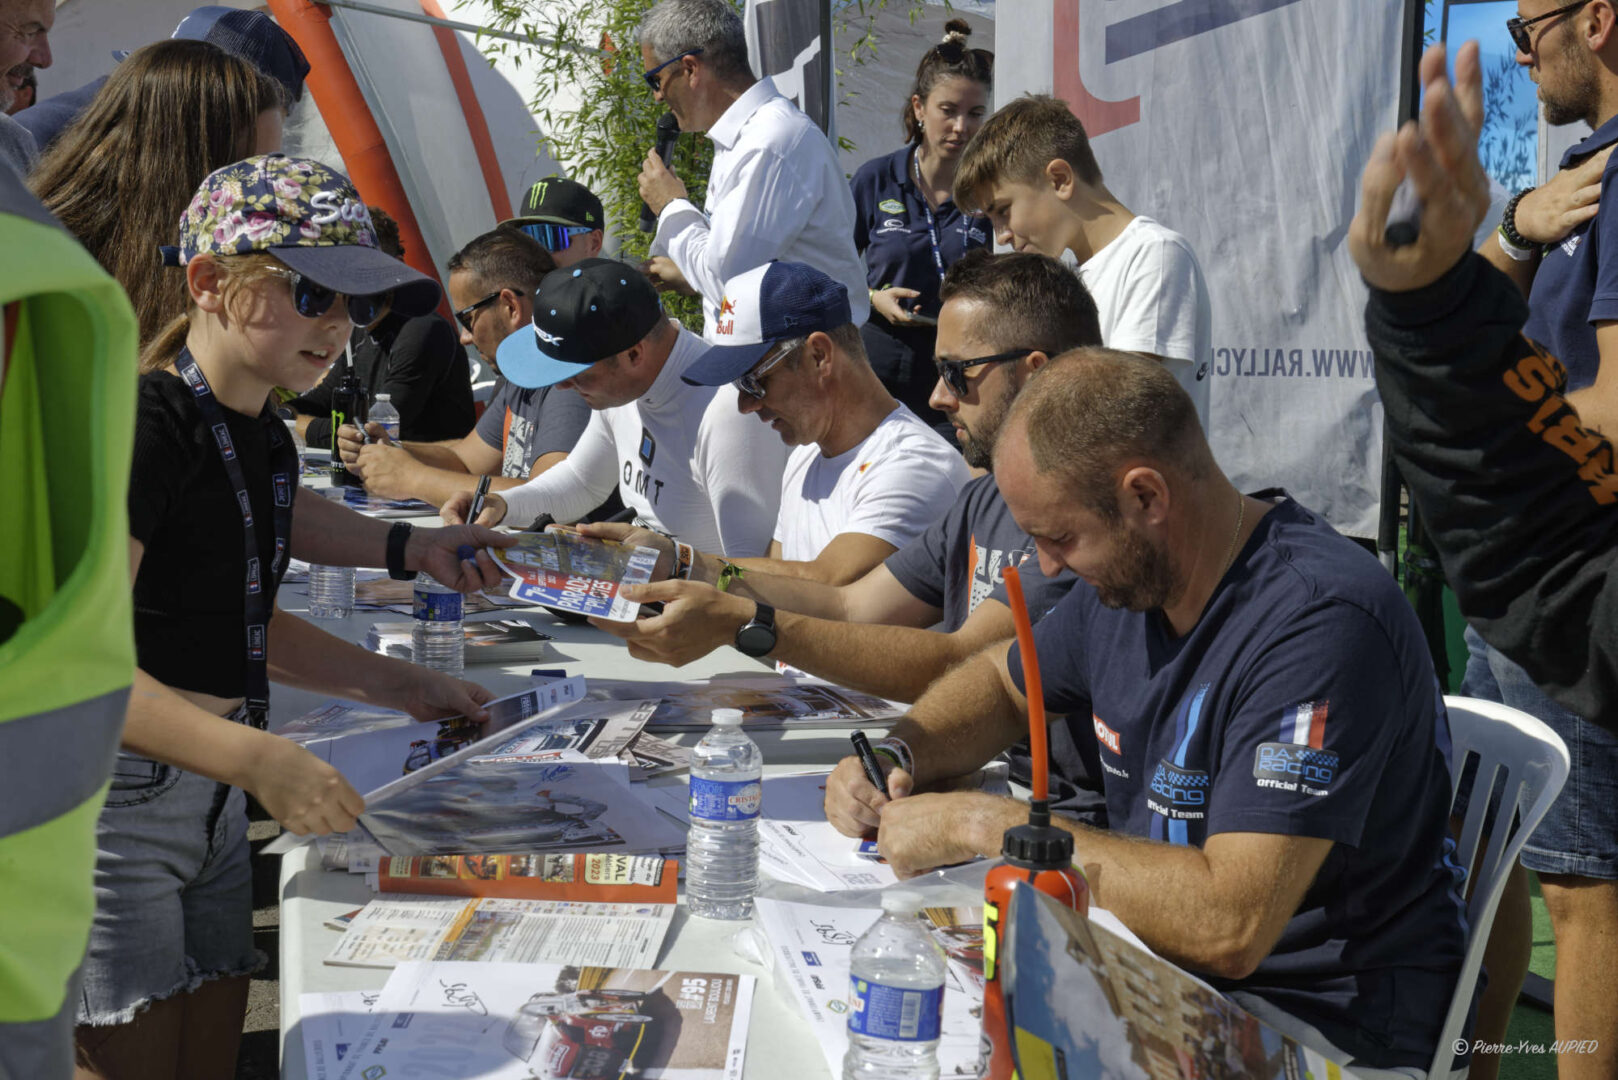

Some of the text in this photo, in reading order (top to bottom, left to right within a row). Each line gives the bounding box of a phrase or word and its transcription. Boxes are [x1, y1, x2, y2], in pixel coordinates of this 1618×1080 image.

[716, 320, 734, 335] Bull
[556, 574, 592, 610] PARADE
[590, 579, 614, 610] PILOTES
[1258, 758, 1333, 784] Racing
[1150, 778, 1205, 805] Racing
[1256, 778, 1329, 796] Official Team
[1170, 808, 1204, 819] Team
[615, 857, 627, 881] VAL
